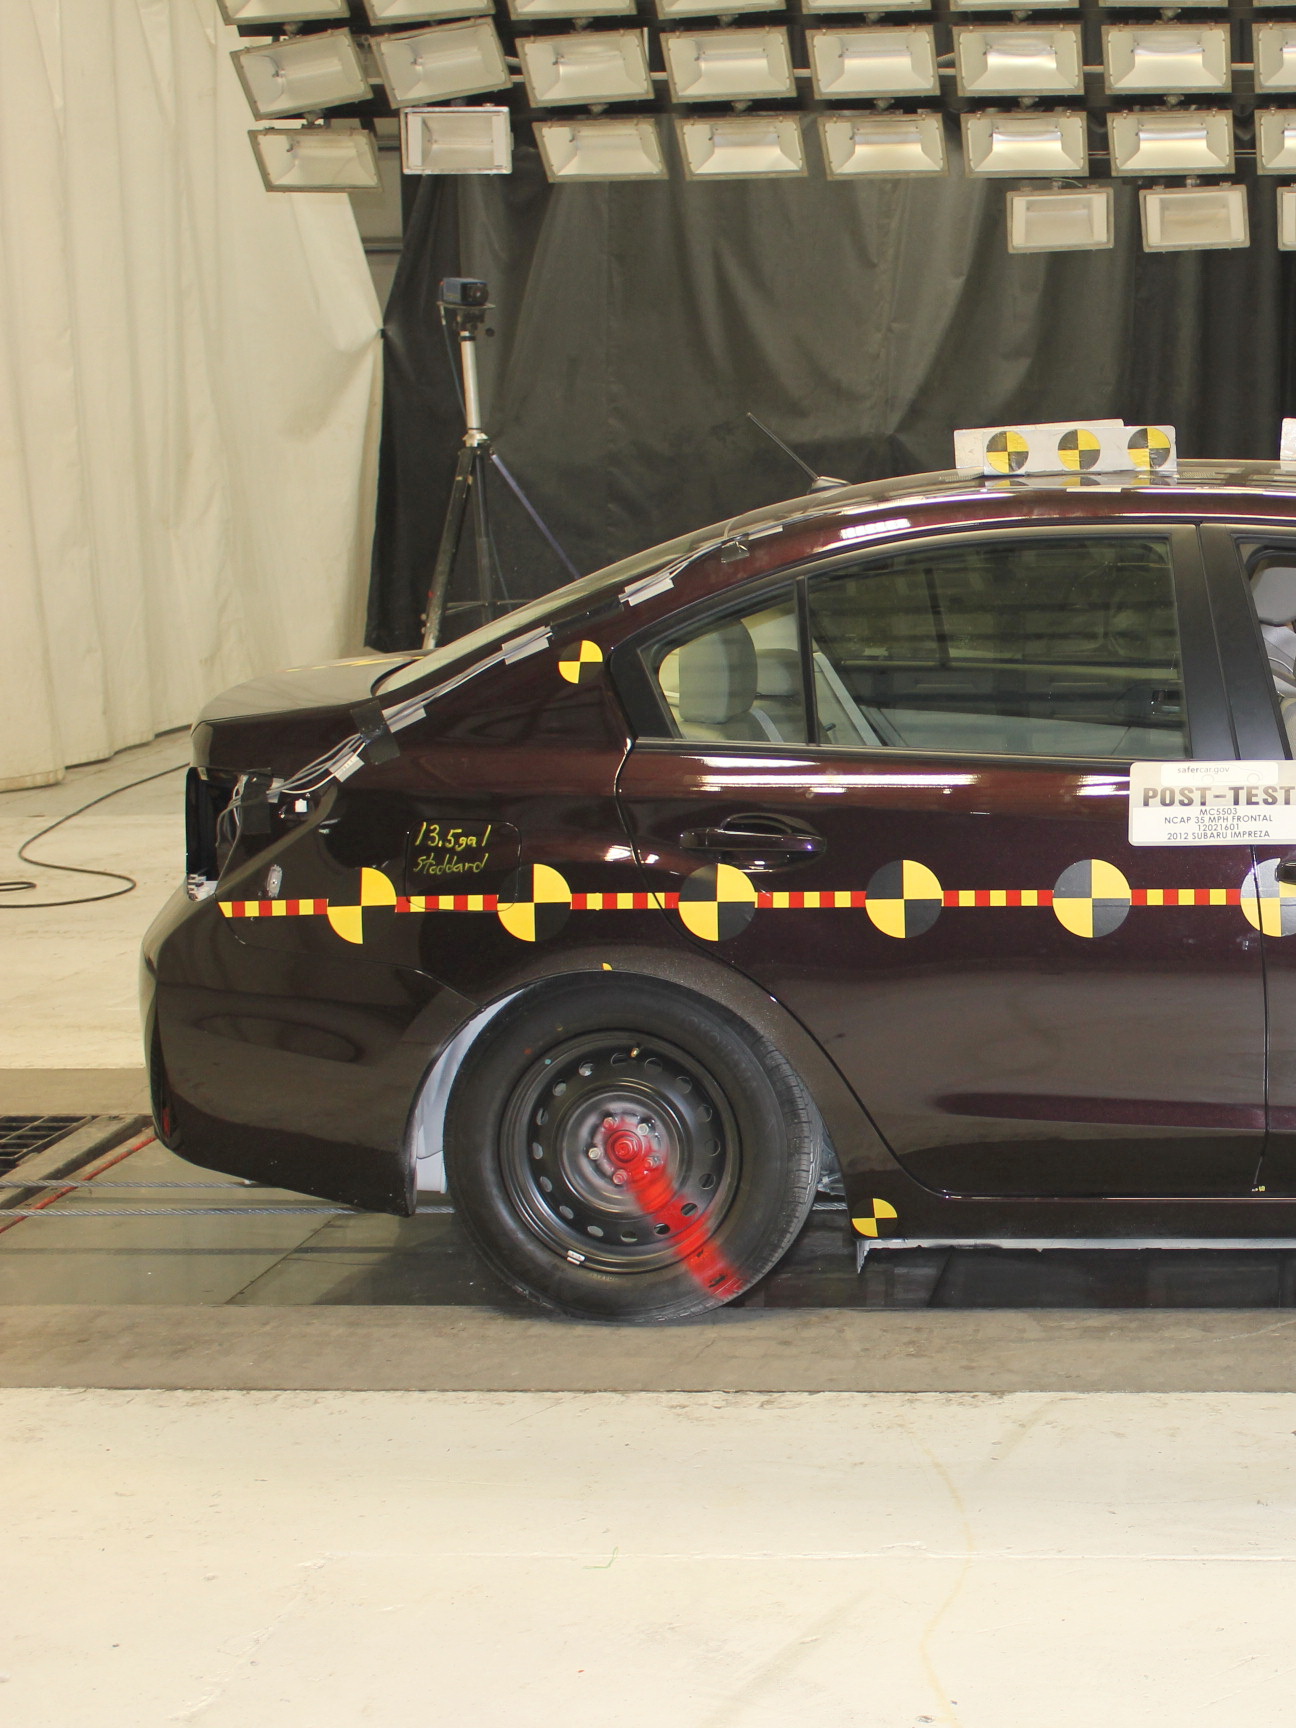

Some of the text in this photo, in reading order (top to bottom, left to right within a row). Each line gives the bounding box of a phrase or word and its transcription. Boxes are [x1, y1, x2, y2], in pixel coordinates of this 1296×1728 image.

[1177, 765, 1230, 774] safercar.gov
[1142, 785, 1296, 807] POST-TEST
[1199, 808, 1238, 816] MC5503
[1164, 816, 1192, 824] NCAP
[1194, 816, 1205, 824] 35
[1231, 814, 1273, 823] FRONTAL
[1197, 824, 1240, 832] 12021601
[1230, 830, 1270, 838] IMPREZA
